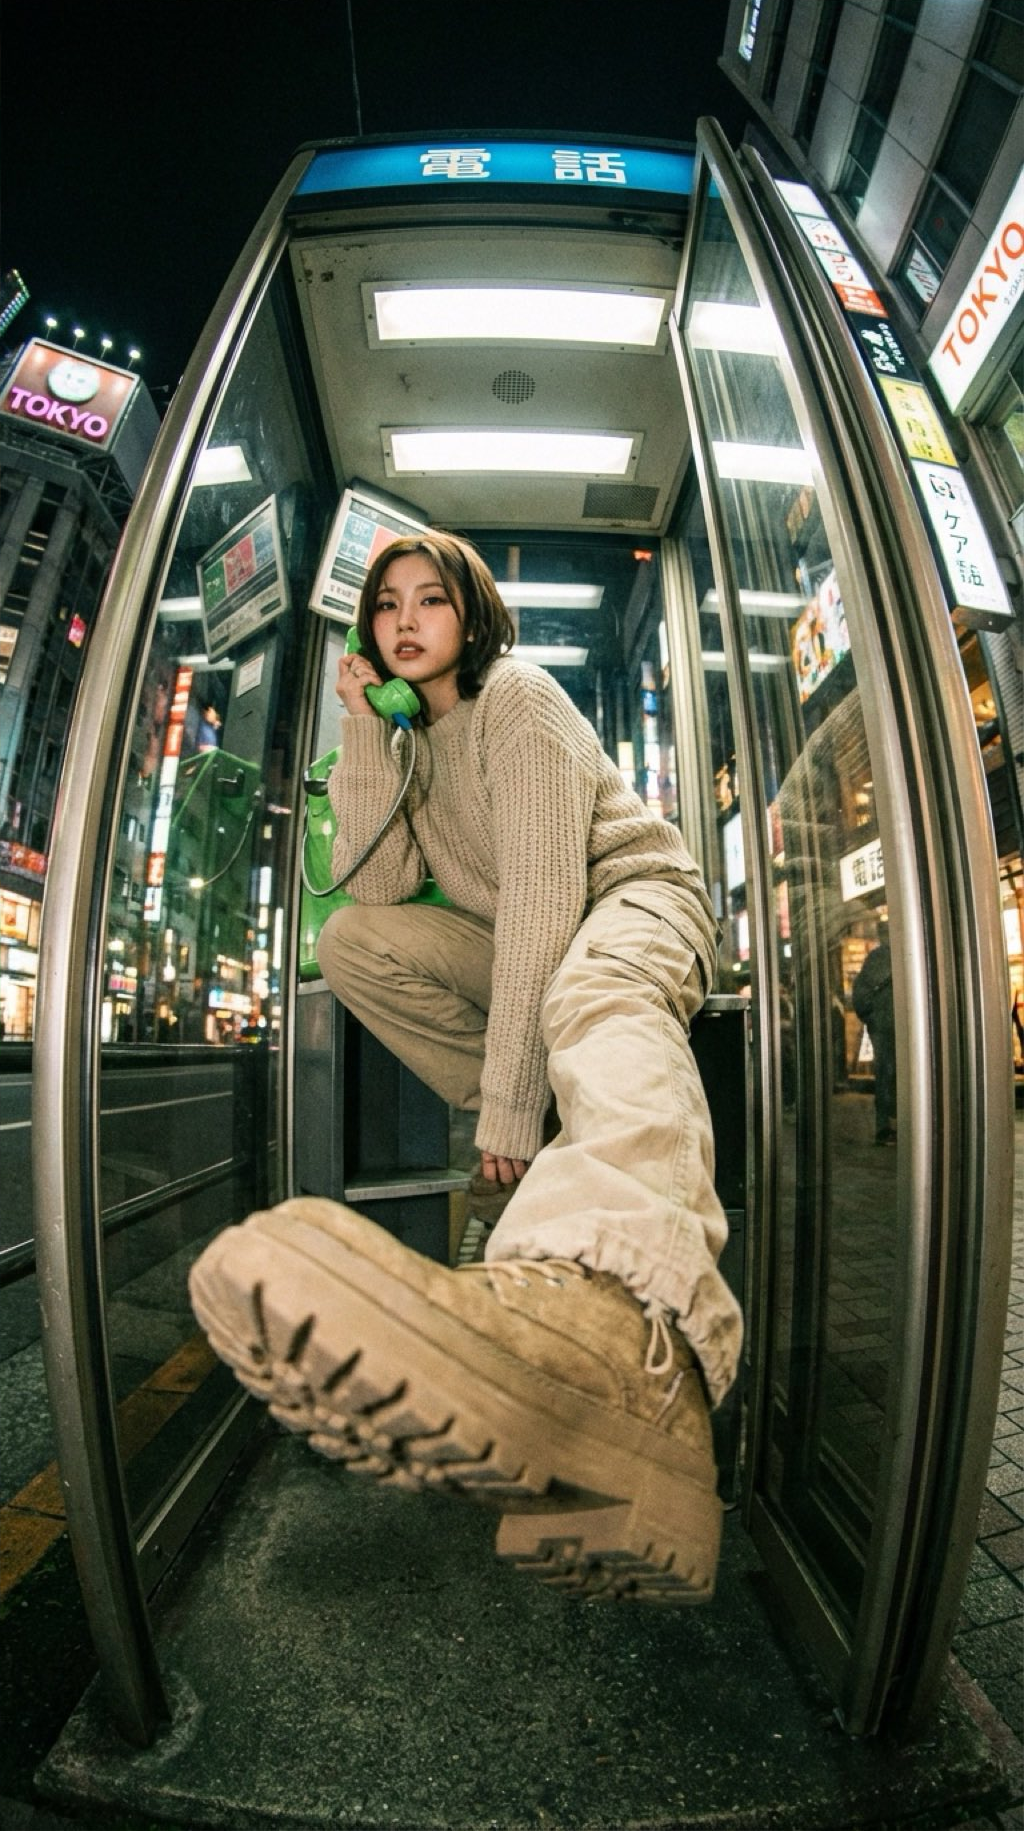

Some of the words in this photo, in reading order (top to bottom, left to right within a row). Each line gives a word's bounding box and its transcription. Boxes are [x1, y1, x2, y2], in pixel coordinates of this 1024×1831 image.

[420, 148, 626, 184] 電話
[942, 221, 1024, 367] TOKYO
[11, 386, 108, 438] TOKYO
